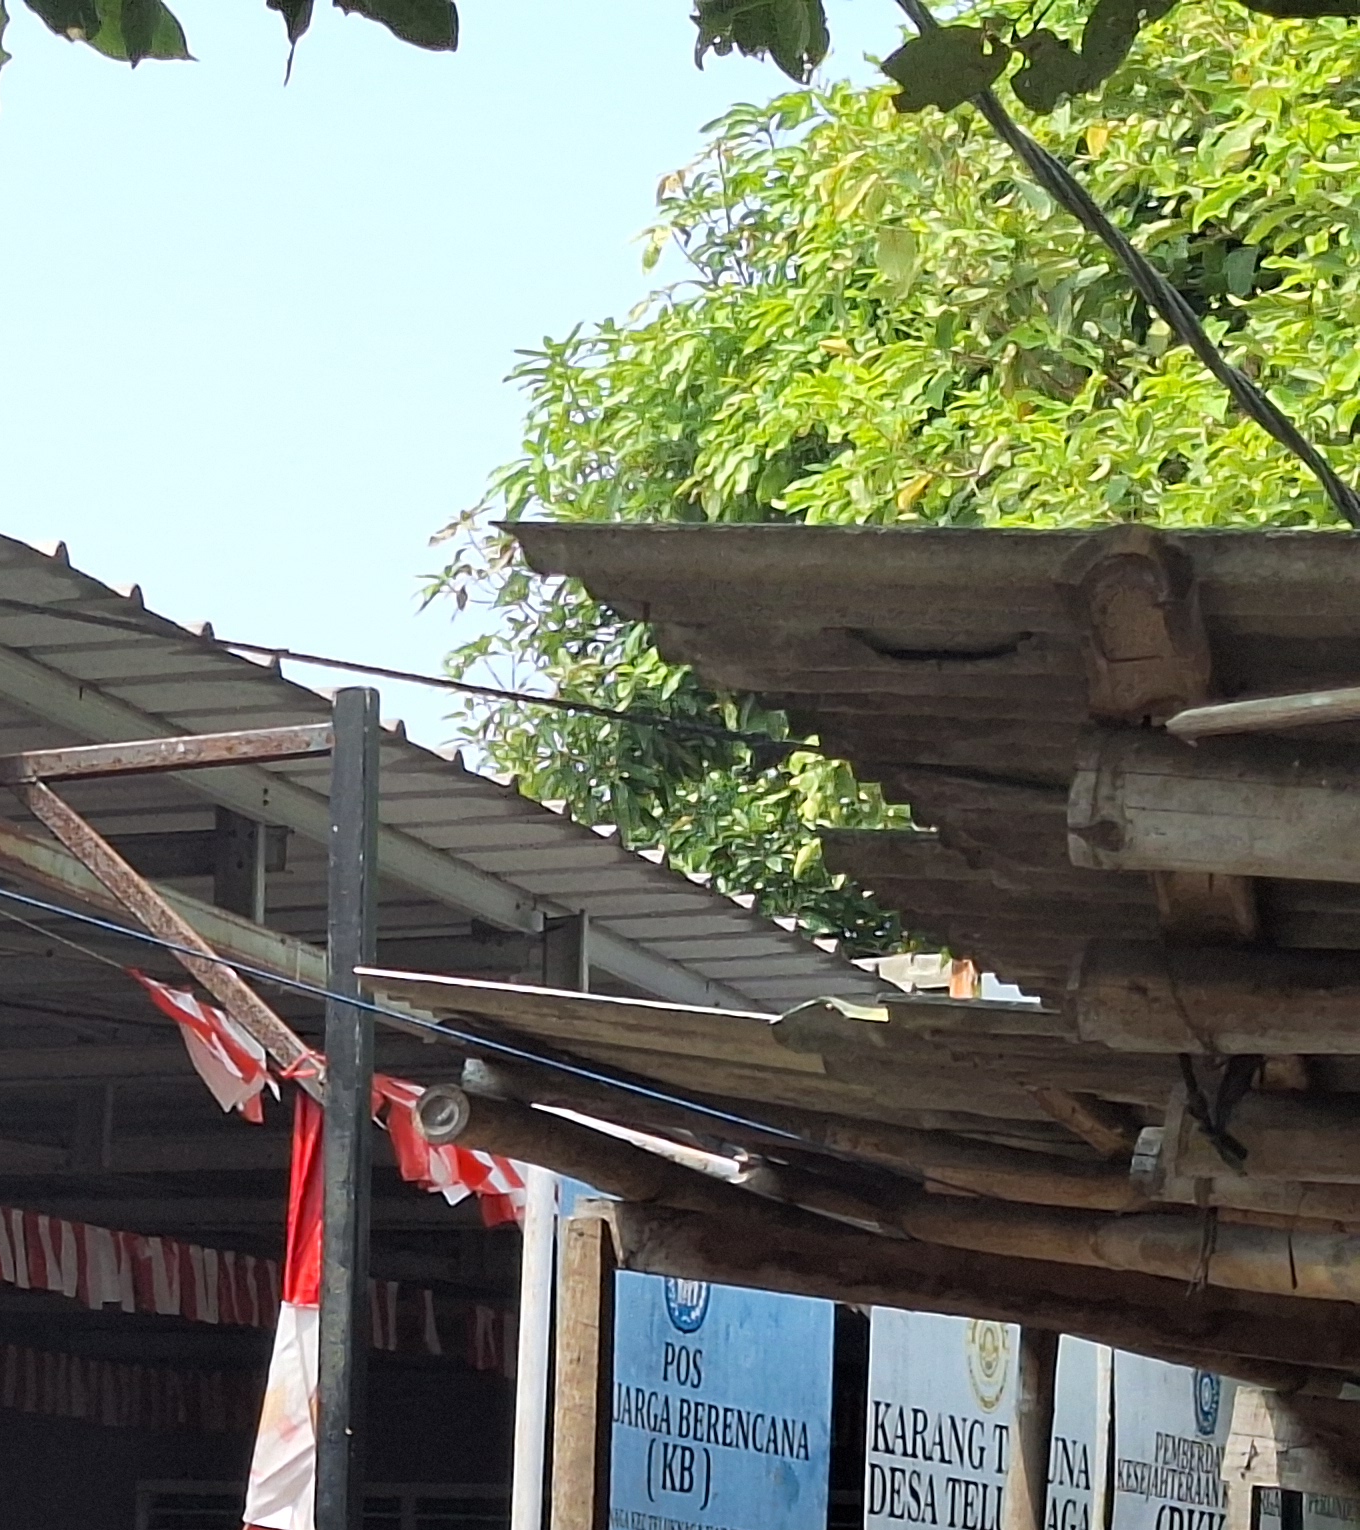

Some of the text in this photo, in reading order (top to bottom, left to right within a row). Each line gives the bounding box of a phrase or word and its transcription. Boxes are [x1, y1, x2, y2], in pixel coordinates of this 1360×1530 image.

[662, 1341, 703, 1389] POS
[677, 1397, 811, 1462] BERENCANA
[871, 1400, 986, 1471] KARANG
[867, 1462, 939, 1525] DESA
